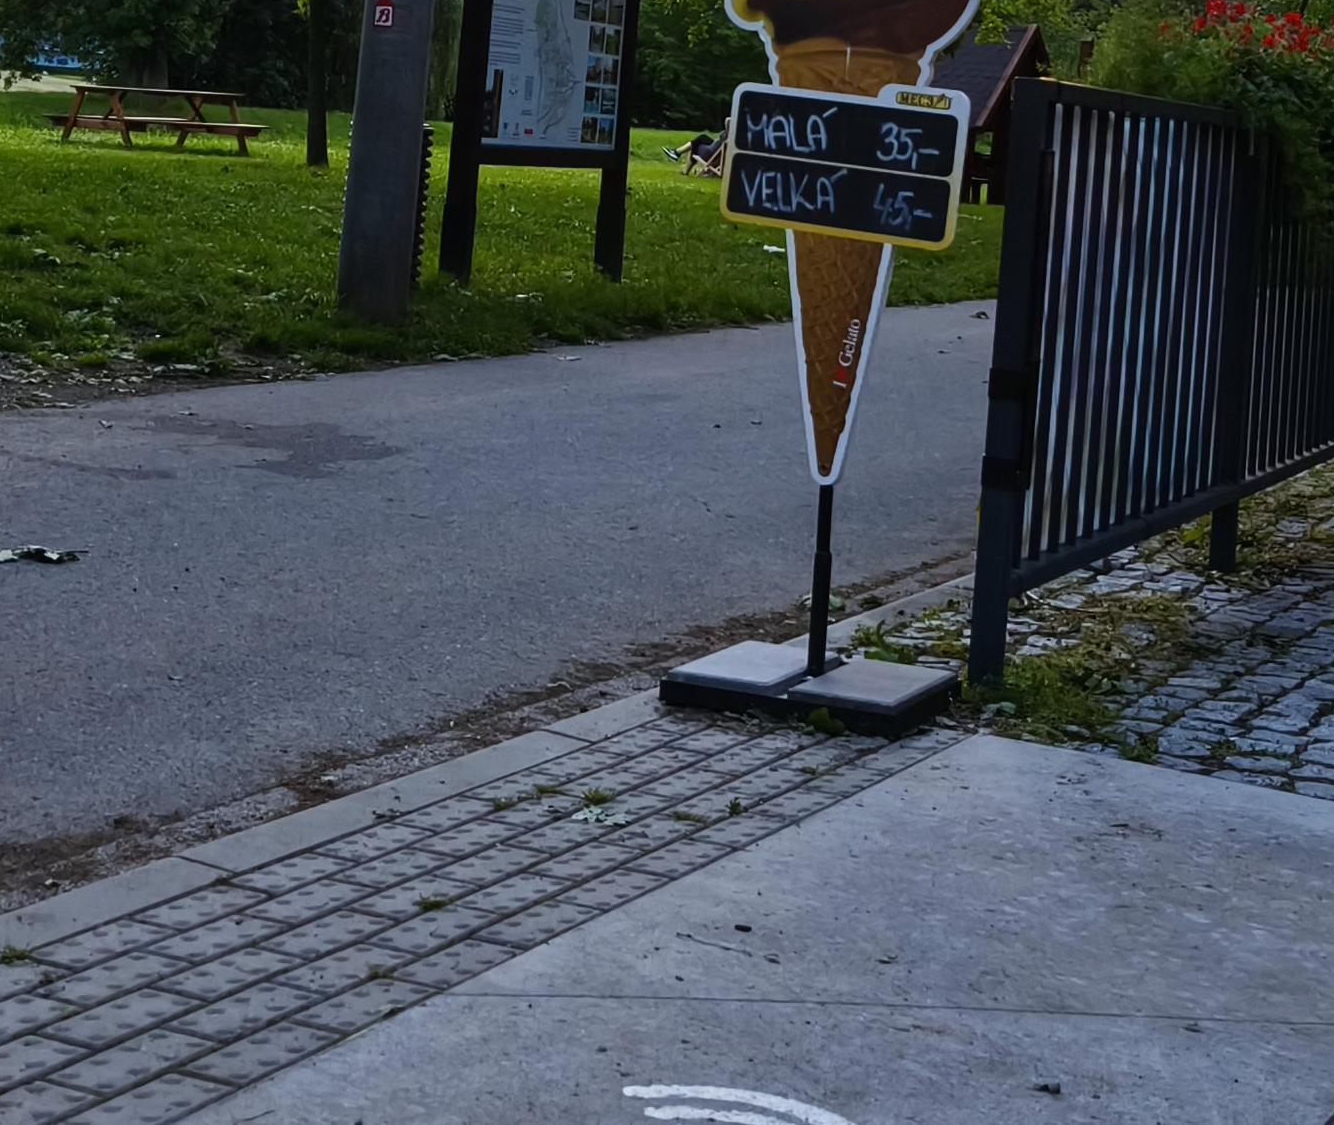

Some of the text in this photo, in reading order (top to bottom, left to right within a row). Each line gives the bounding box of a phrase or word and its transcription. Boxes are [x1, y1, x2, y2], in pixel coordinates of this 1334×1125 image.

[746, 106, 940, 170] MALÁ 35,-
[741, 167, 848, 214] VELKÁ
